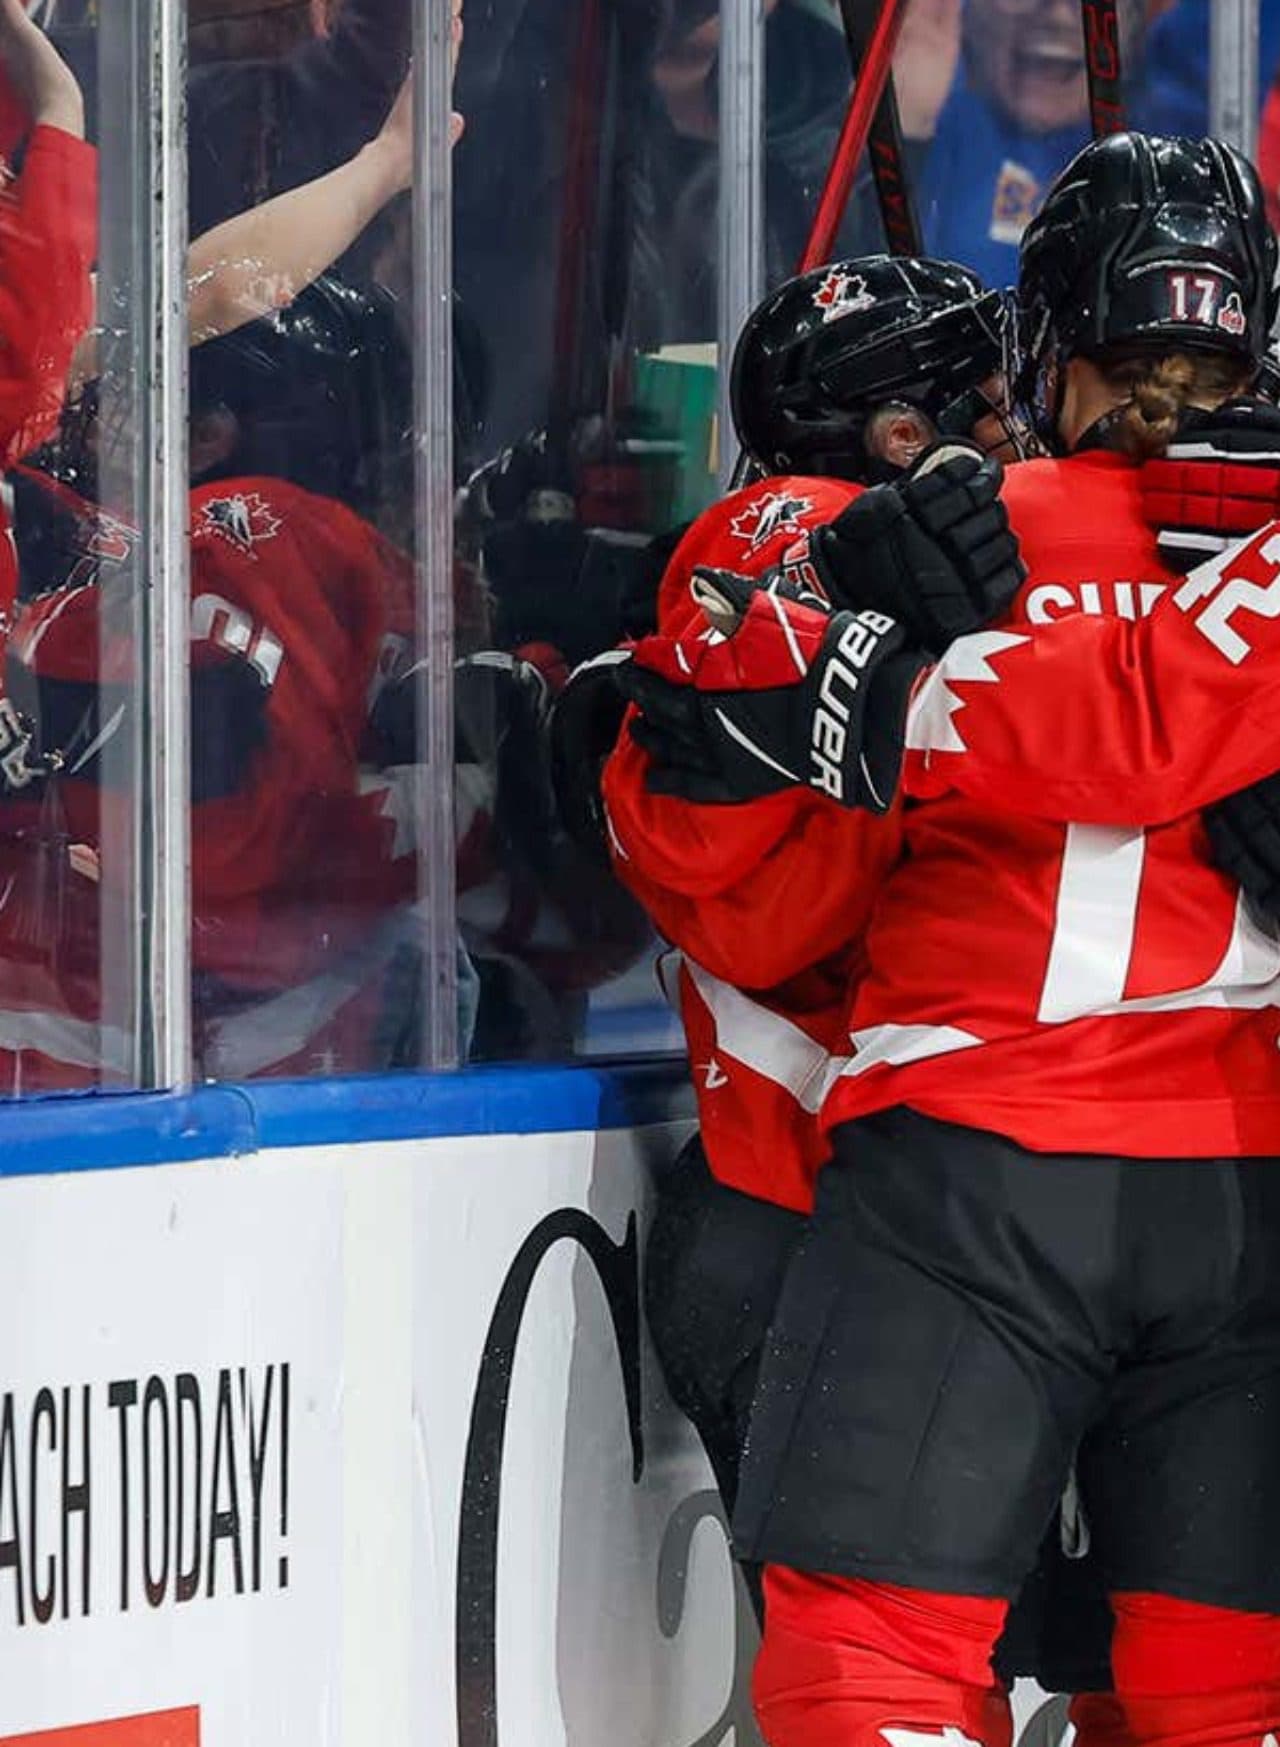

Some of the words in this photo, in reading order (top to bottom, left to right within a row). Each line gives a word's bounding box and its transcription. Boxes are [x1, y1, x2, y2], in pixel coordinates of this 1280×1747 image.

[1169, 273, 1218, 325] 17
[809, 609, 896, 800] BAUER
[107, 1361, 291, 1612] TODAY!
